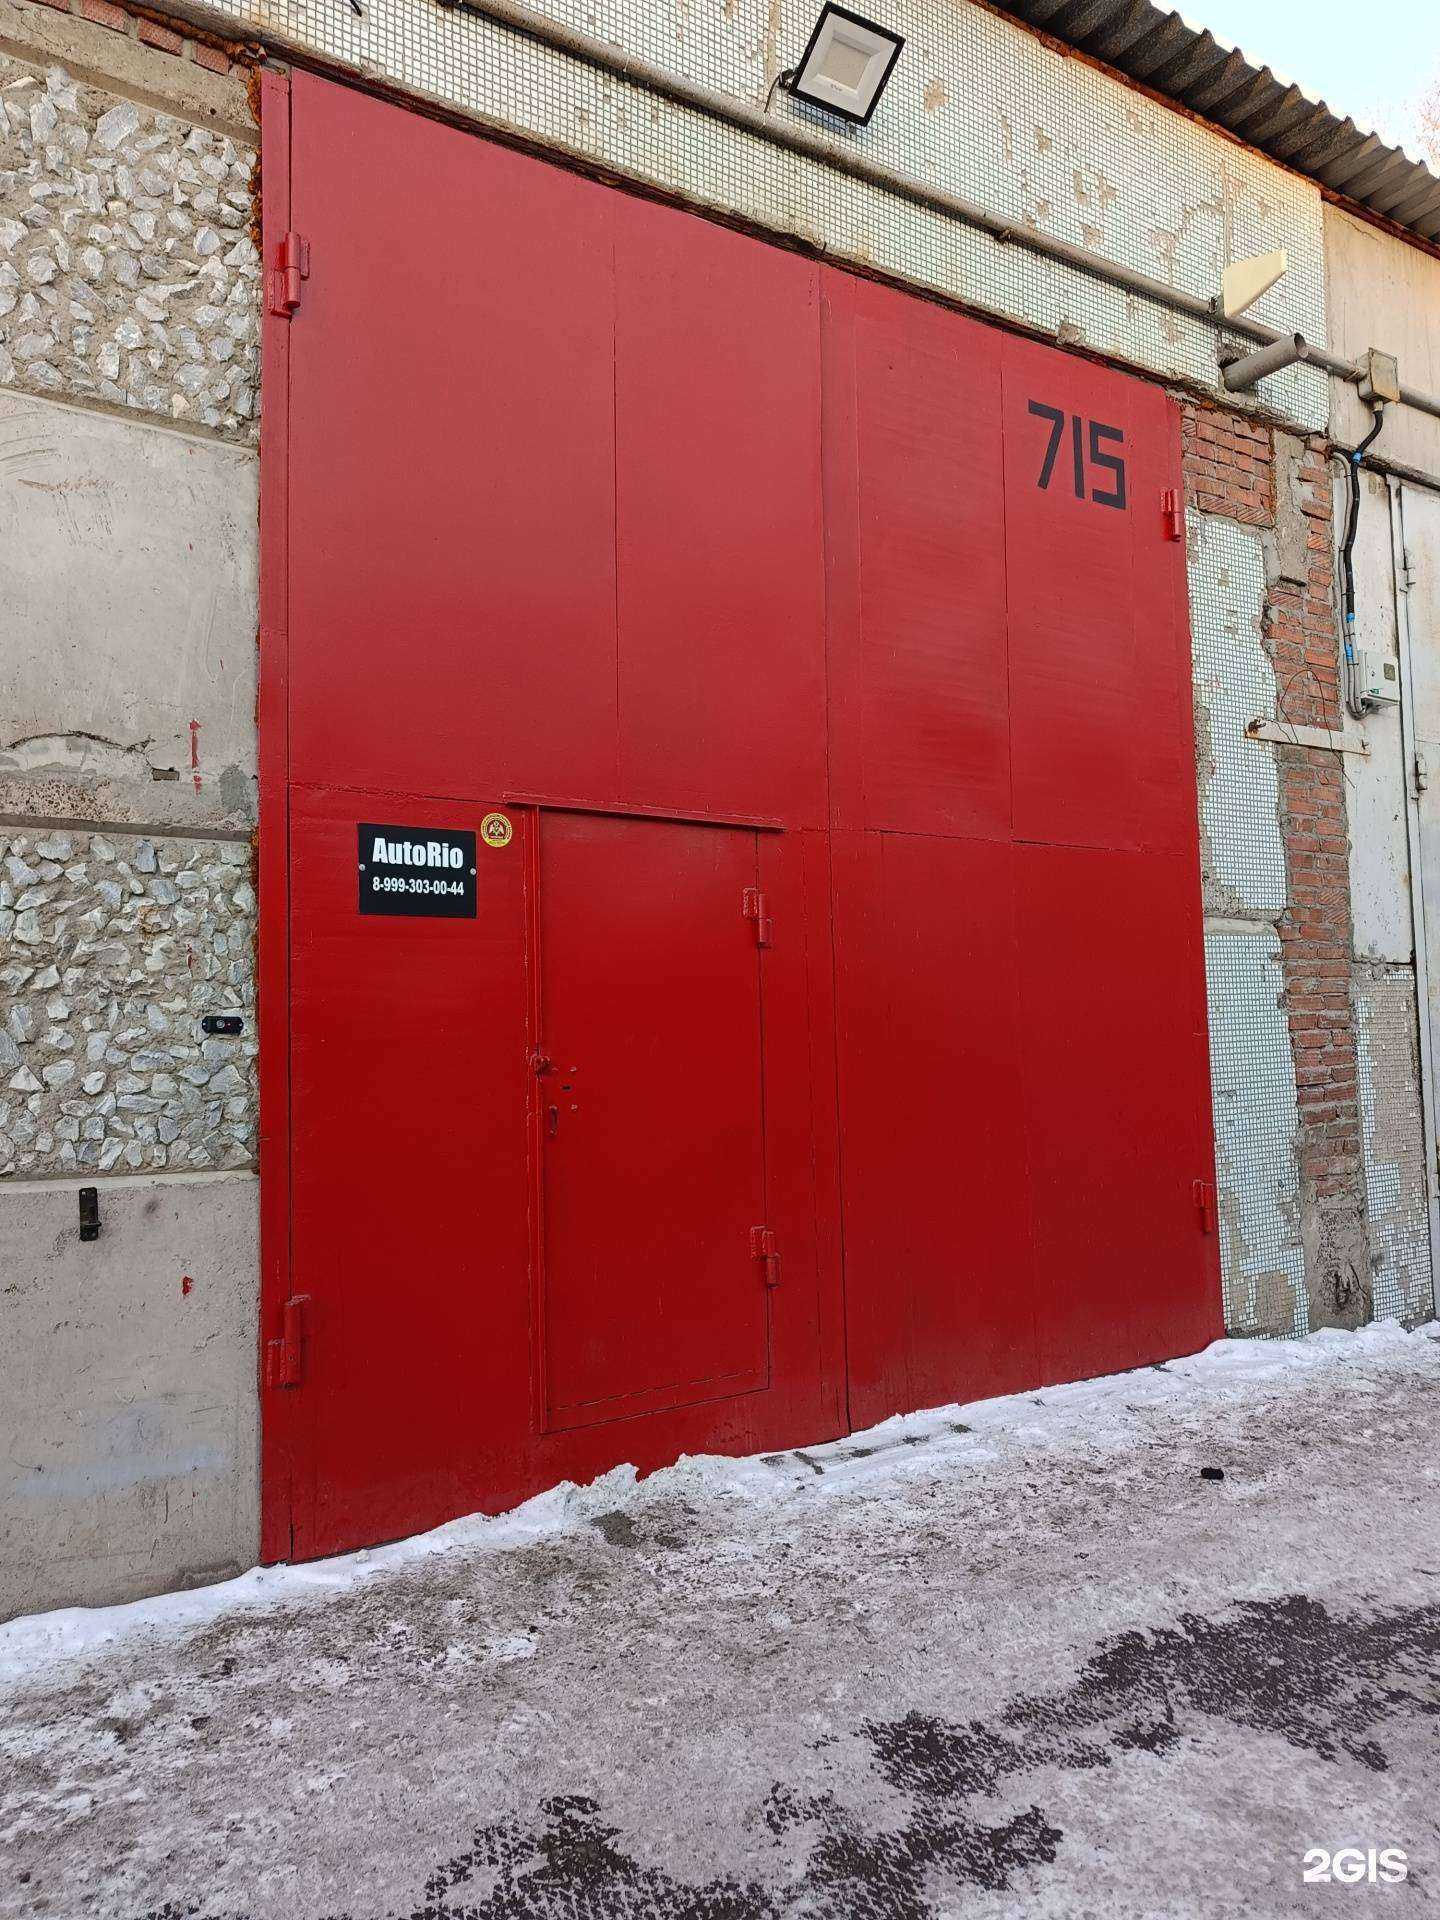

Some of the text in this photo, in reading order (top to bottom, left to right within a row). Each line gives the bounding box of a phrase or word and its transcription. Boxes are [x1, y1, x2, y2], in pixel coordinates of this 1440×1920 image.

[1028, 399, 1126, 510] 715
[372, 837, 464, 869] AutoRio
[372, 876, 465, 896] 8-999-303-00-44
